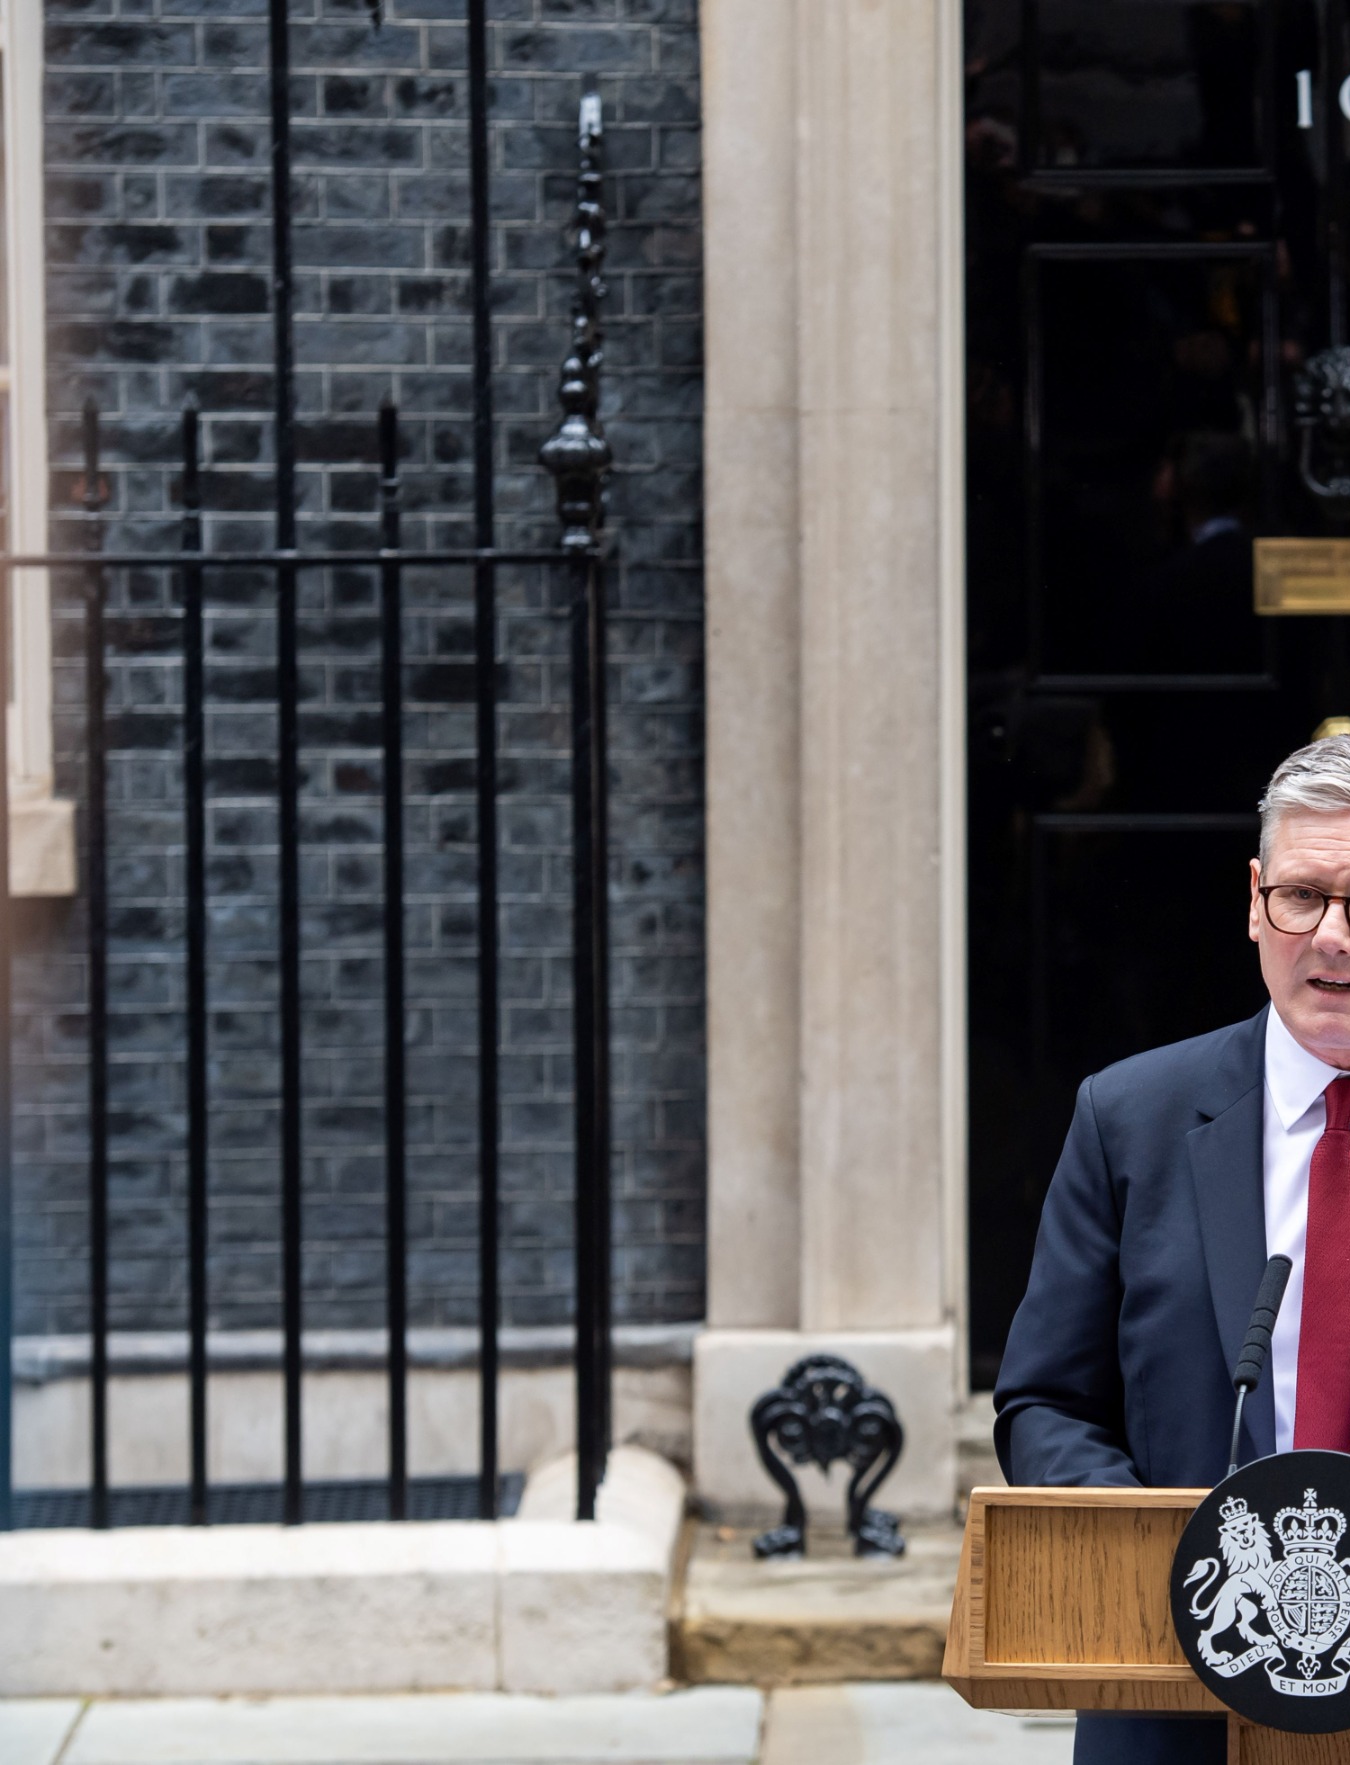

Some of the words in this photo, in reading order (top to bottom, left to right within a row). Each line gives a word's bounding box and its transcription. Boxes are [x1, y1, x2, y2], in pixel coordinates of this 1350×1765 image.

[1294, 1554, 1320, 1566] QUI
[1323, 1560, 1346, 1585] MAL
[1271, 1562, 1291, 1590] SOIT
[1341, 1587, 1350, 1596] Y
[1270, 1613, 1285, 1632] HO
[1328, 1601, 1350, 1639] PENSE
[1229, 1645, 1265, 1673] DIEU
[1280, 1680, 1296, 1692] ET
[1303, 1681, 1338, 1693] MON
